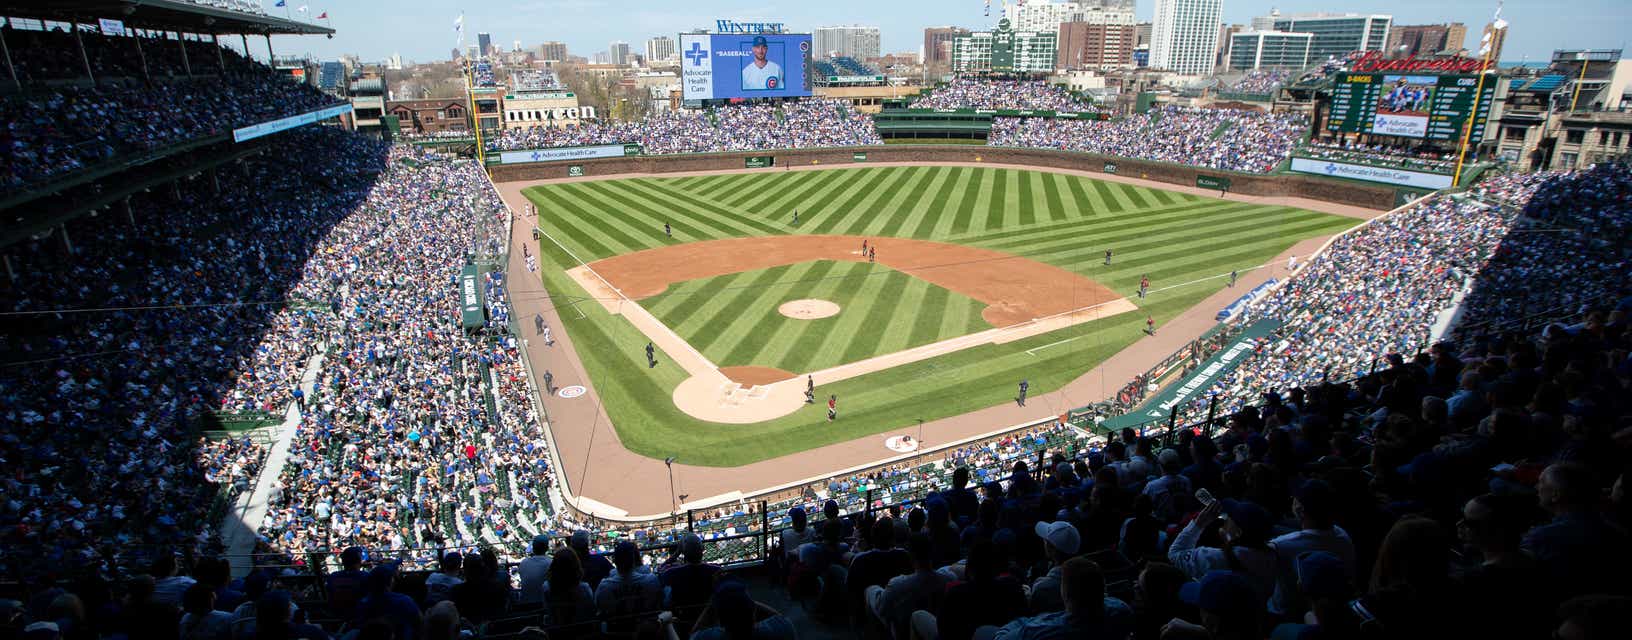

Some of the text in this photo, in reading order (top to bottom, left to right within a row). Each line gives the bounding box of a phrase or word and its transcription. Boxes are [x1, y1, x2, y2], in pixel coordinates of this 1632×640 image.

[1352, 50, 1494, 73] Budweiser
[684, 69, 712, 77] Advocate
[1456, 78, 1477, 86] CUBS
[505, 105, 596, 122] nuveen
[1388, 119, 1418, 127] Advocate
[542, 150, 566, 159] Advocate
[567, 149, 584, 157] Health
[1337, 165, 1410, 181] Advocate Health Care
